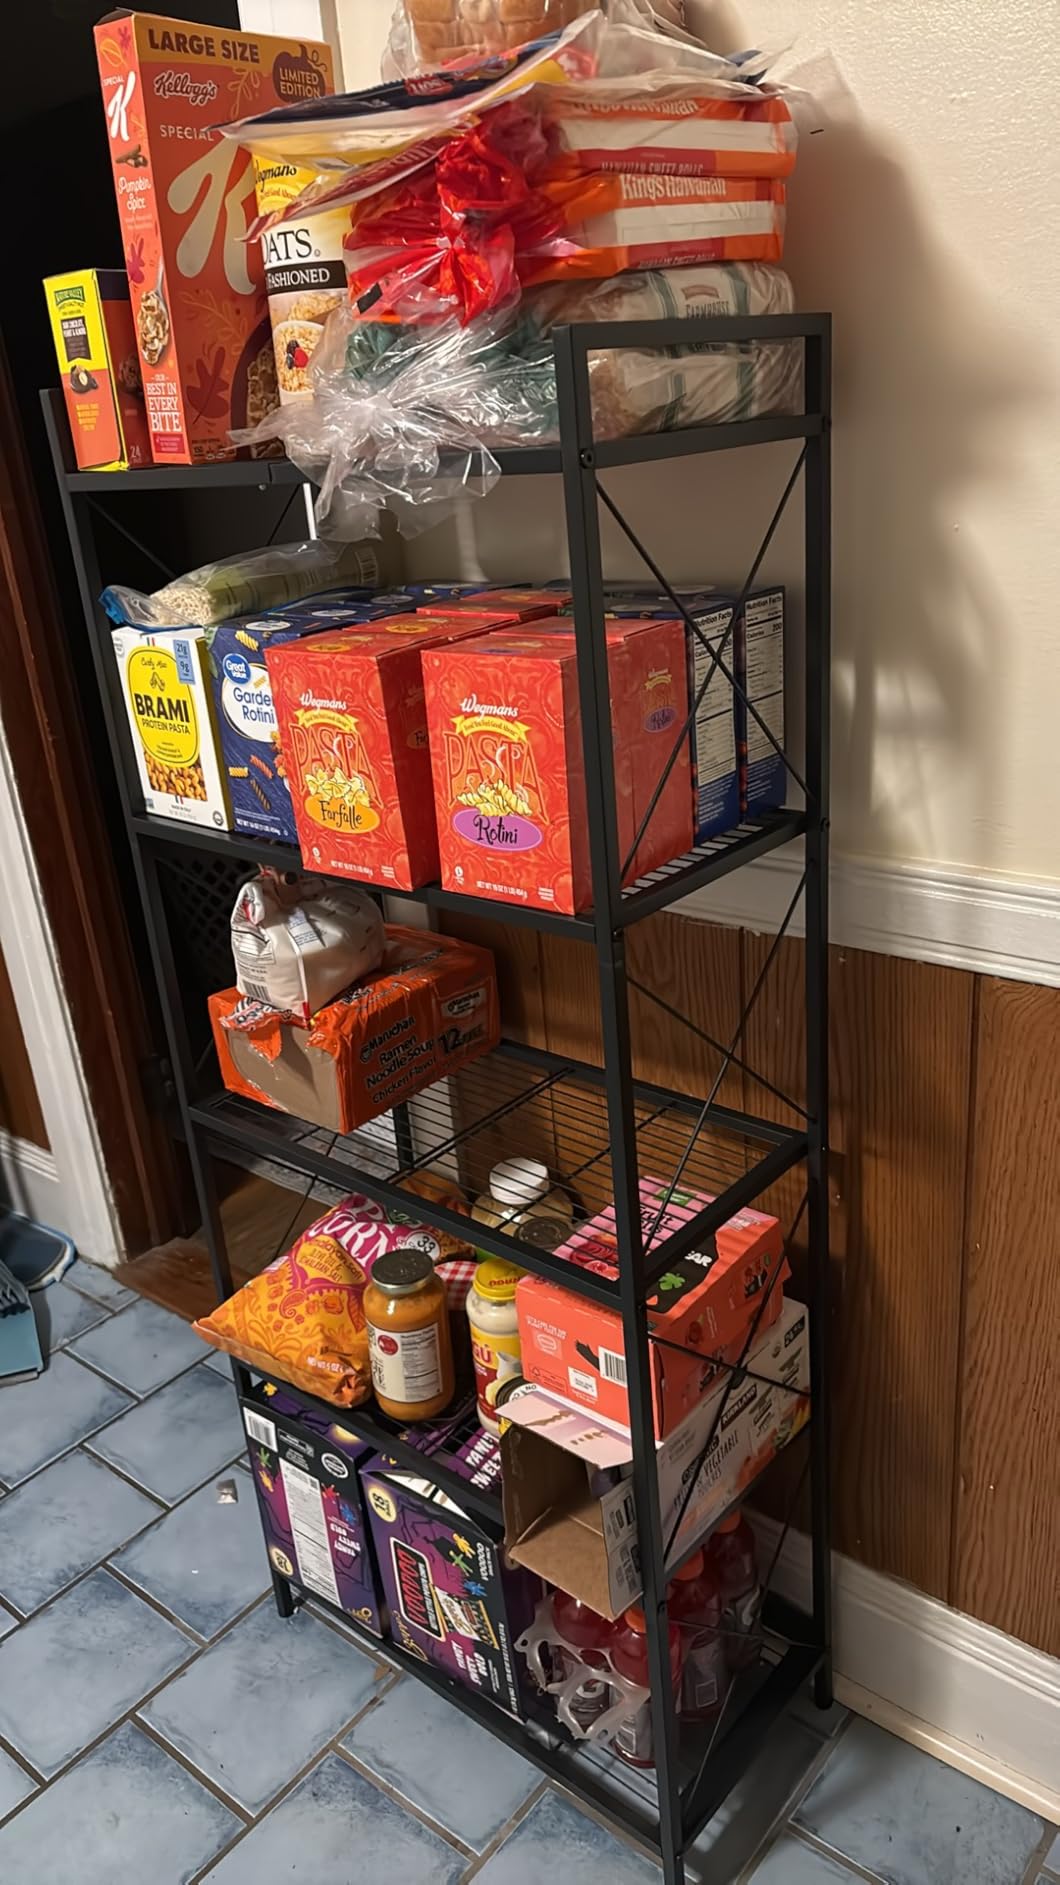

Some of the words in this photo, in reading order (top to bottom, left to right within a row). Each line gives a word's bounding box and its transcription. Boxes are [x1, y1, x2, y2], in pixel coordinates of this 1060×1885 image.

[147, 28, 216, 58] LARGE
[221, 39, 261, 64] SIZE
[102, 75, 125, 87] SPECIAL
[154, 69, 218, 106] Kellogg's
[279, 67, 320, 86] LIMITED
[280, 81, 322, 98] EDITION
[107, 70, 136, 142] K
[159, 124, 214, 141] SPECIAL
[119, 176, 152, 196] Pumpkin
[619, 174, 665, 200] King's
[666, 176, 727, 198] Hawaiian
[126, 197, 147, 213] Spice
[145, 382, 167, 396] BEST
[167, 382, 178, 395] IN
[148, 396, 178, 412] EVERY
[151, 411, 182, 433] BITE
[225, 659, 247, 673] Great
[134, 692, 191, 723] BRAMI
[233, 686, 274, 708] Garde
[299, 688, 348, 712] Wegmans
[459, 693, 519, 721] Wegmans
[141, 717, 169, 731] PROTEIN
[168, 722, 191, 736] PASTA
[242, 704, 276, 725] Rotini
[288, 722, 385, 809] PASTA
[442, 730, 549, 825] PASTA
[319, 800, 363, 831] Farfalle
[472, 813, 518, 846] Rotini
[368, 1015, 416, 1052] Maruchan
[437, 1027, 461, 1054] 12
[379, 1035, 418, 1064] Ramen
[366, 1055, 408, 1090] Noodle
[407, 1039, 434, 1061] Soup
[372, 1076, 410, 1104] Chicken
[409, 1056, 437, 1079] Flavor
[417, 1235, 437, 1254] 33
[373, 1493, 387, 1512] 18
[475, 1542, 490, 1582] VOODOO
[396, 1548, 429, 1626] VOODOO
[451, 1639, 467, 1670] TANGY
[473, 1652, 488, 1677] BOLD
[465, 1654, 482, 1686] SWEET
